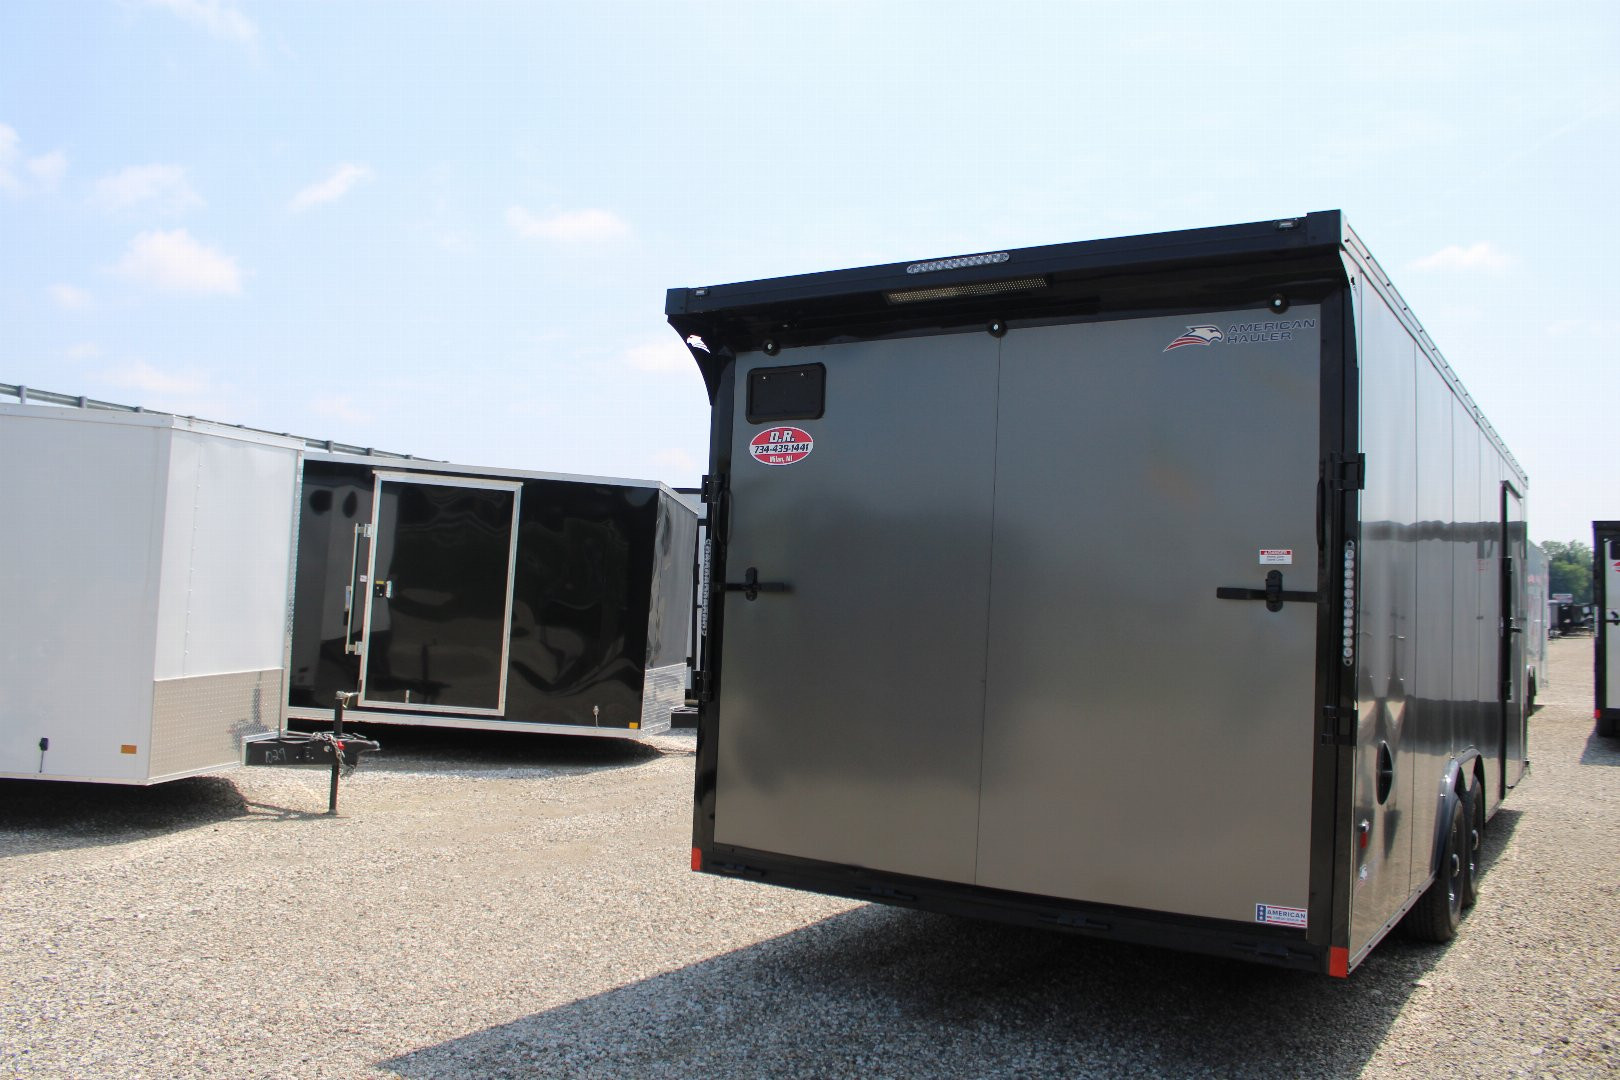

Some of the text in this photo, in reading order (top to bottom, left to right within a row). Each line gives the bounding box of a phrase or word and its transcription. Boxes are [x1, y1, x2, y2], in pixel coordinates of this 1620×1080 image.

[1228, 319, 1316, 334] AMERICAN
[1227, 331, 1293, 344] HAULER
[769, 430, 796, 443] D.R.
[754, 443, 810, 454] 734-439-1441
[1266, 909, 1306, 919] AMERICAN
